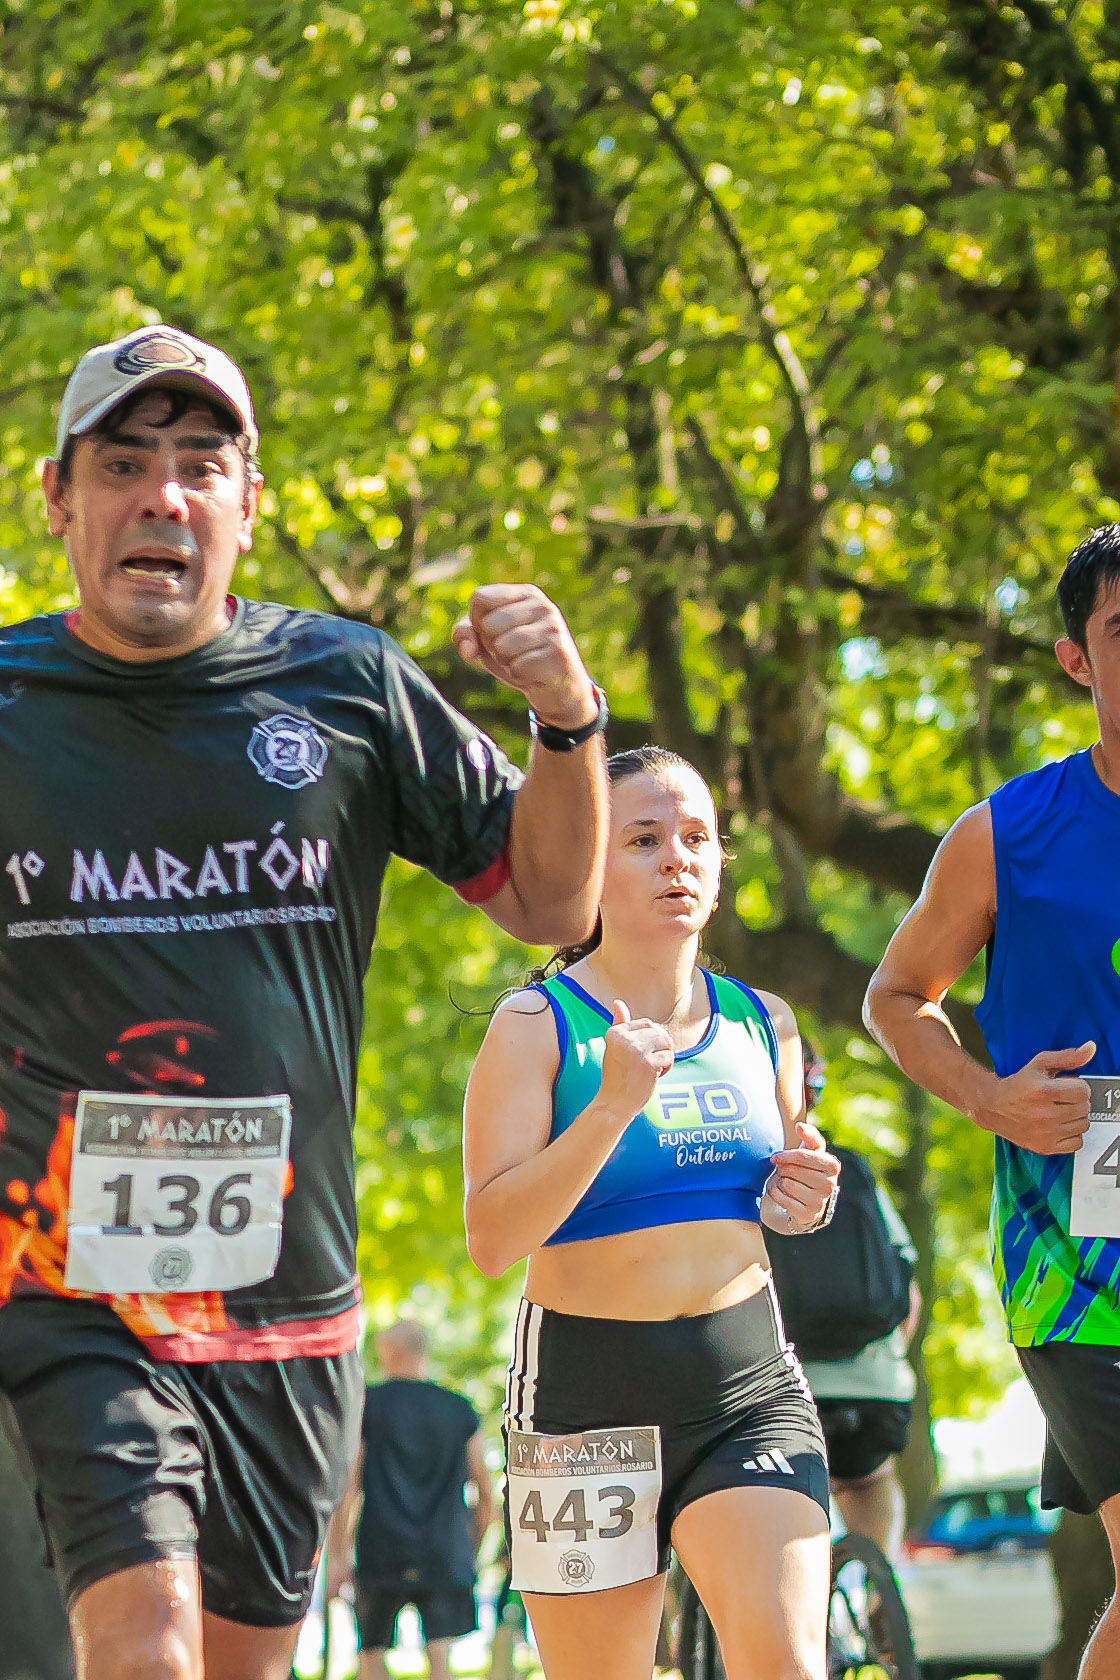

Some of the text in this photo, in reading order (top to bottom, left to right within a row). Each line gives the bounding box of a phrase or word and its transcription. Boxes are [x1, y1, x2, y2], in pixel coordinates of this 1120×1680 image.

[71, 820, 329, 902] MARATÓN
[137, 1111, 263, 1143] MARATÓN
[658, 1128, 752, 1147] FUNCIONAL
[676, 1145, 736, 1167] Outdoor
[101, 1172, 253, 1236] 136
[533, 1435, 633, 1464] MARATÓN
[536, 1465, 572, 1477] BOMBEROS
[572, 1463, 620, 1476] VOLUNTARIOS
[621, 1460, 653, 1473] ROSARIO
[519, 1485, 636, 1543] 443
[568, 1561, 584, 1575] 27
